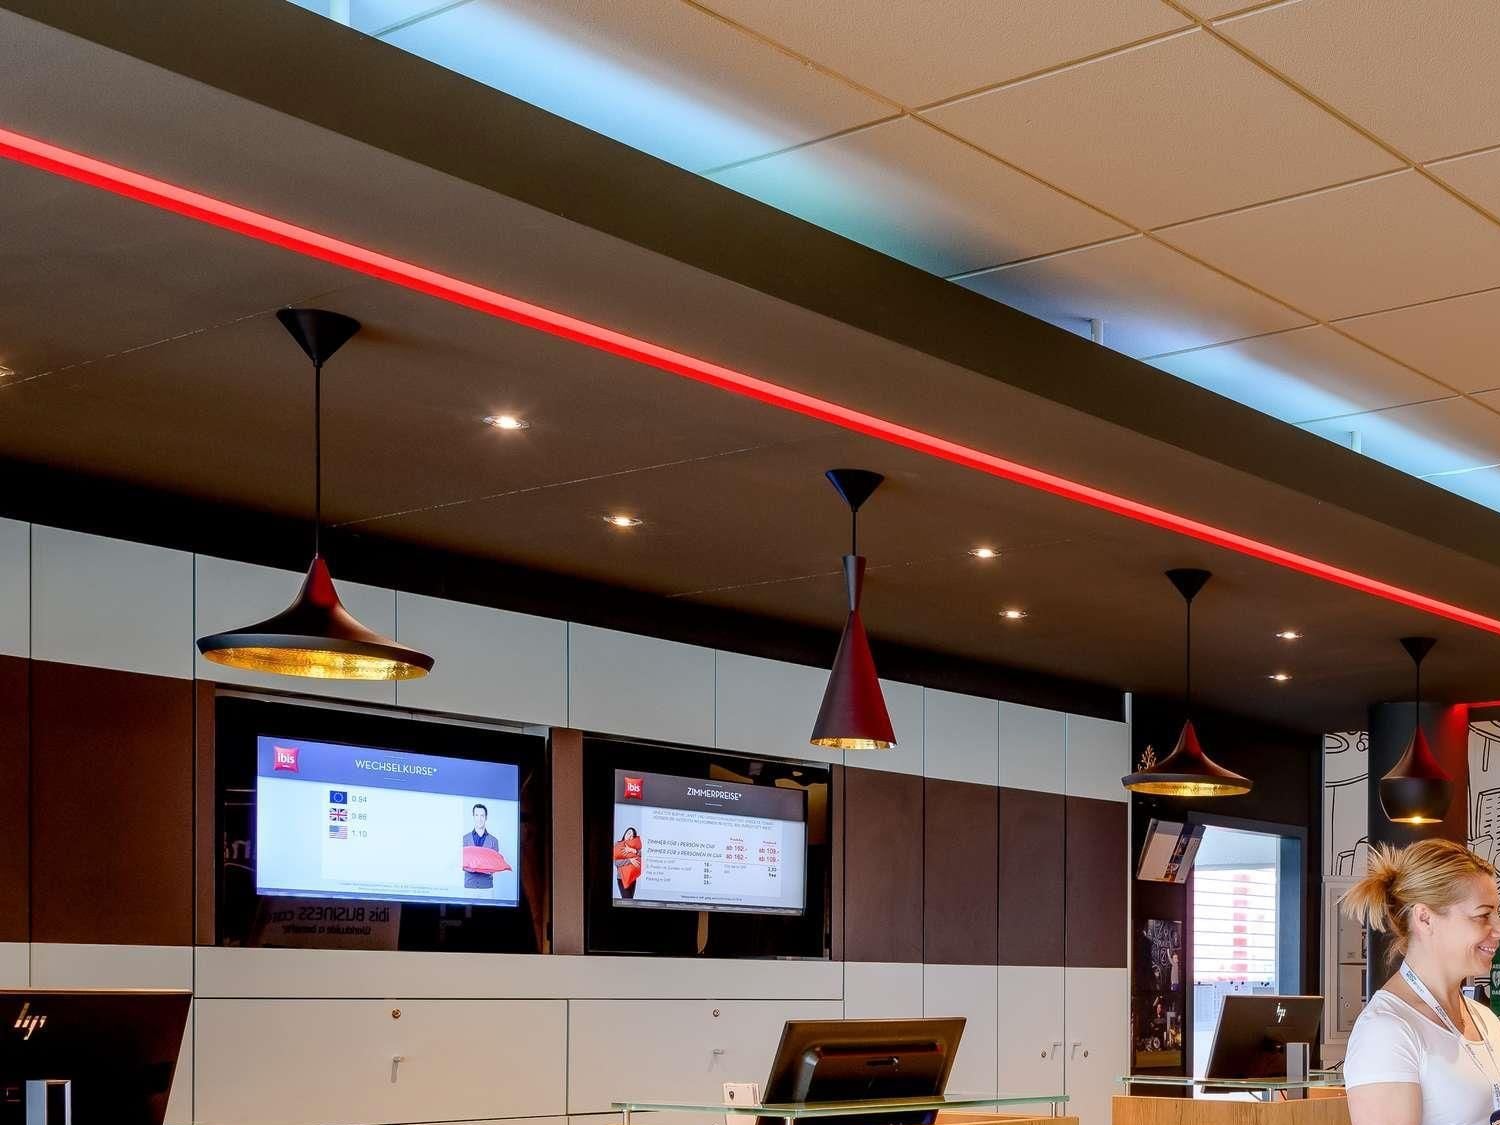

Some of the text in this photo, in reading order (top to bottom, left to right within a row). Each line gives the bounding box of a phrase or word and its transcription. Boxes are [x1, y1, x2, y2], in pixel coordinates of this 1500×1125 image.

[277, 752, 294, 764] ibis
[627, 783, 640, 792] ibis
[14, 1002, 47, 1040] hp
